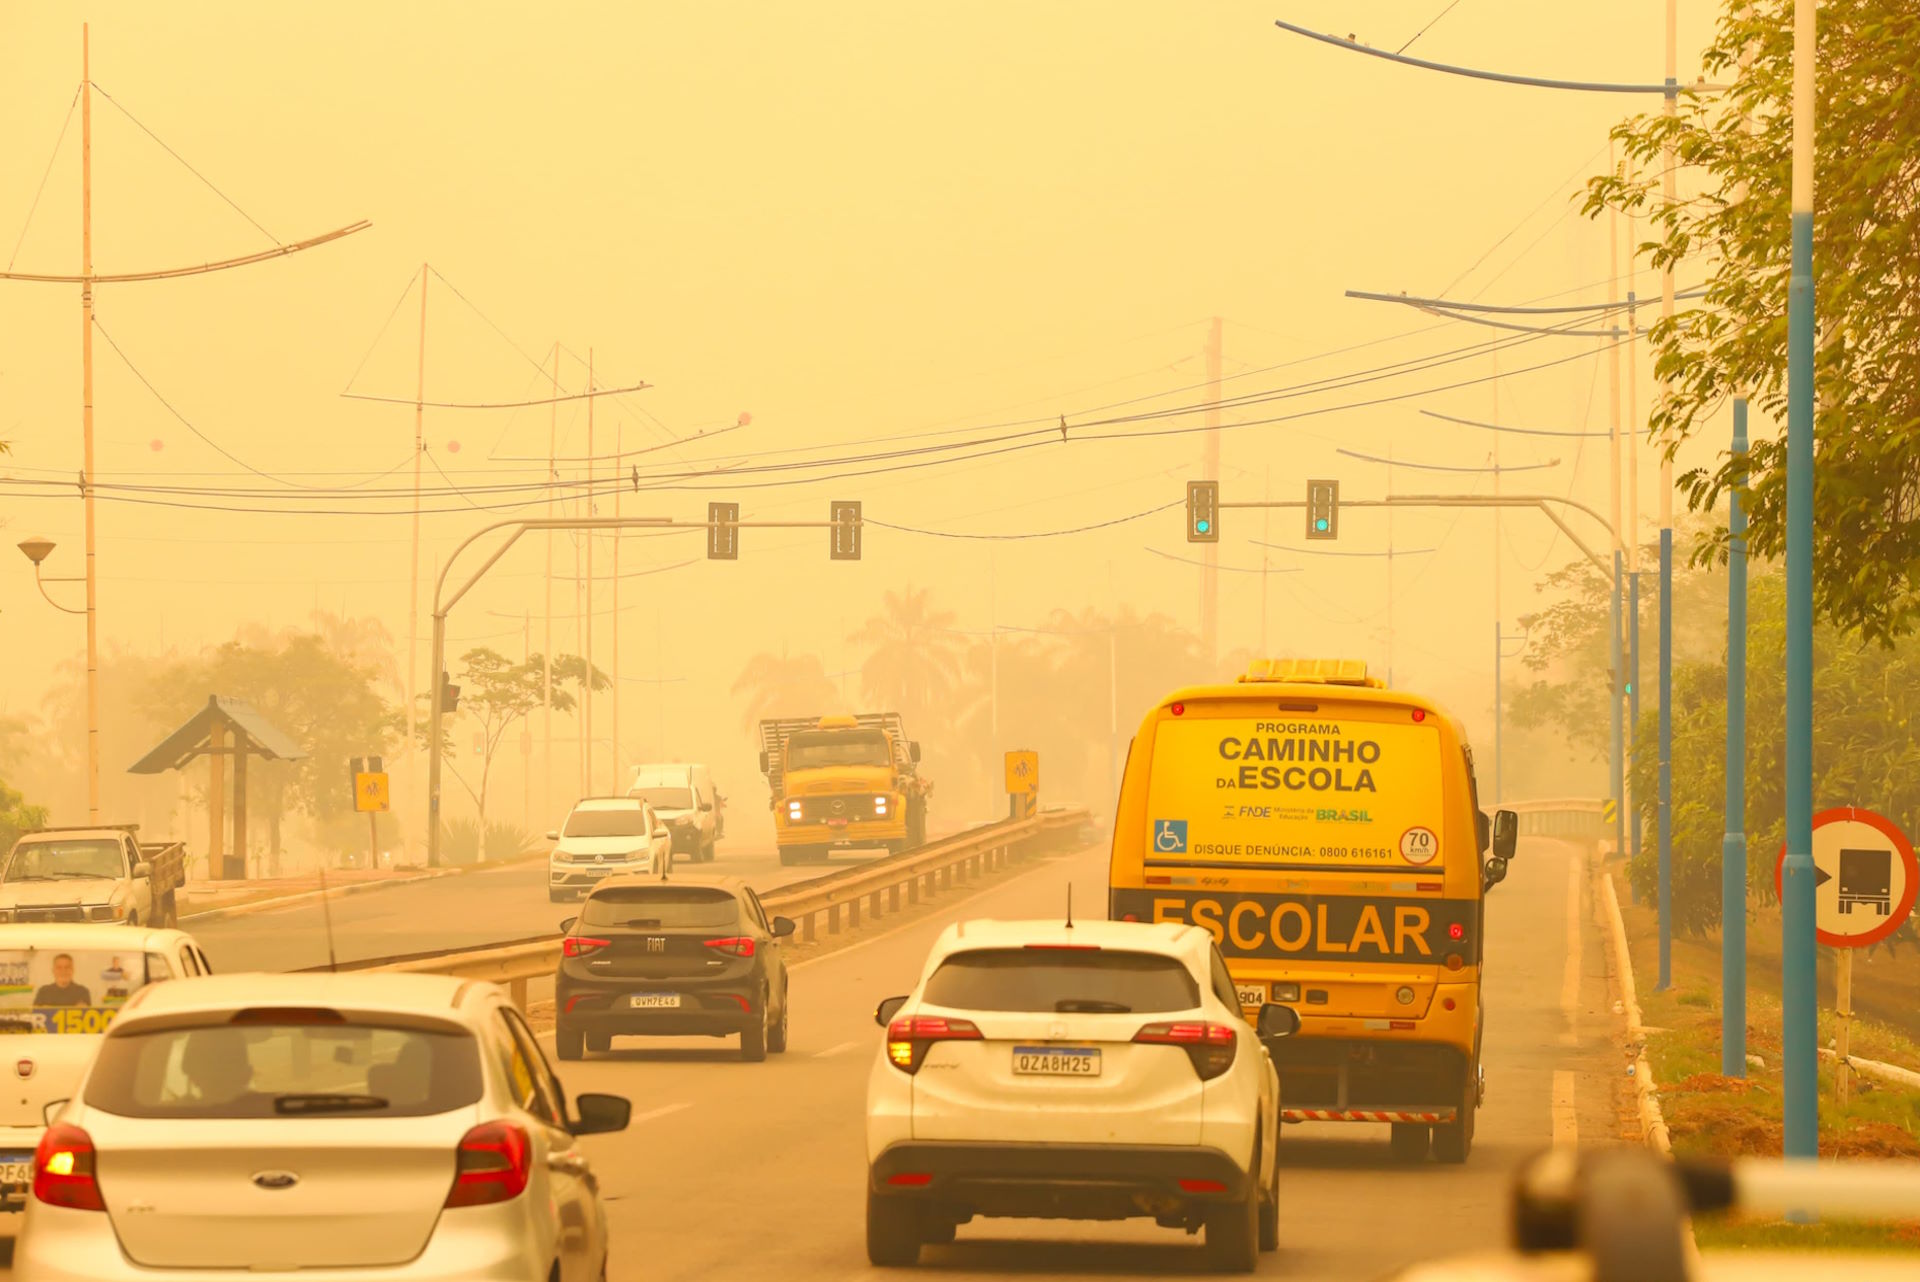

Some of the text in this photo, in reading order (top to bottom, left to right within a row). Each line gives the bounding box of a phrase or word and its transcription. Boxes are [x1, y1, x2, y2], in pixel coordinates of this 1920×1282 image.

[1256, 722, 1341, 735] PROGRAMA
[1218, 737, 1381, 764] CAMINHO
[1216, 765, 1377, 793] DA ESCOLA
[1239, 806, 1271, 818] FNDE
[1316, 808, 1373, 822] BRASIL
[1409, 832, 1429, 847] 70
[1194, 844, 1241, 856] DISQUE
[1246, 843, 1315, 857] DENÚNCIA:
[1320, 847, 1347, 858] 0800
[1351, 848, 1392, 859] 616161
[647, 937, 666, 952] FIAT
